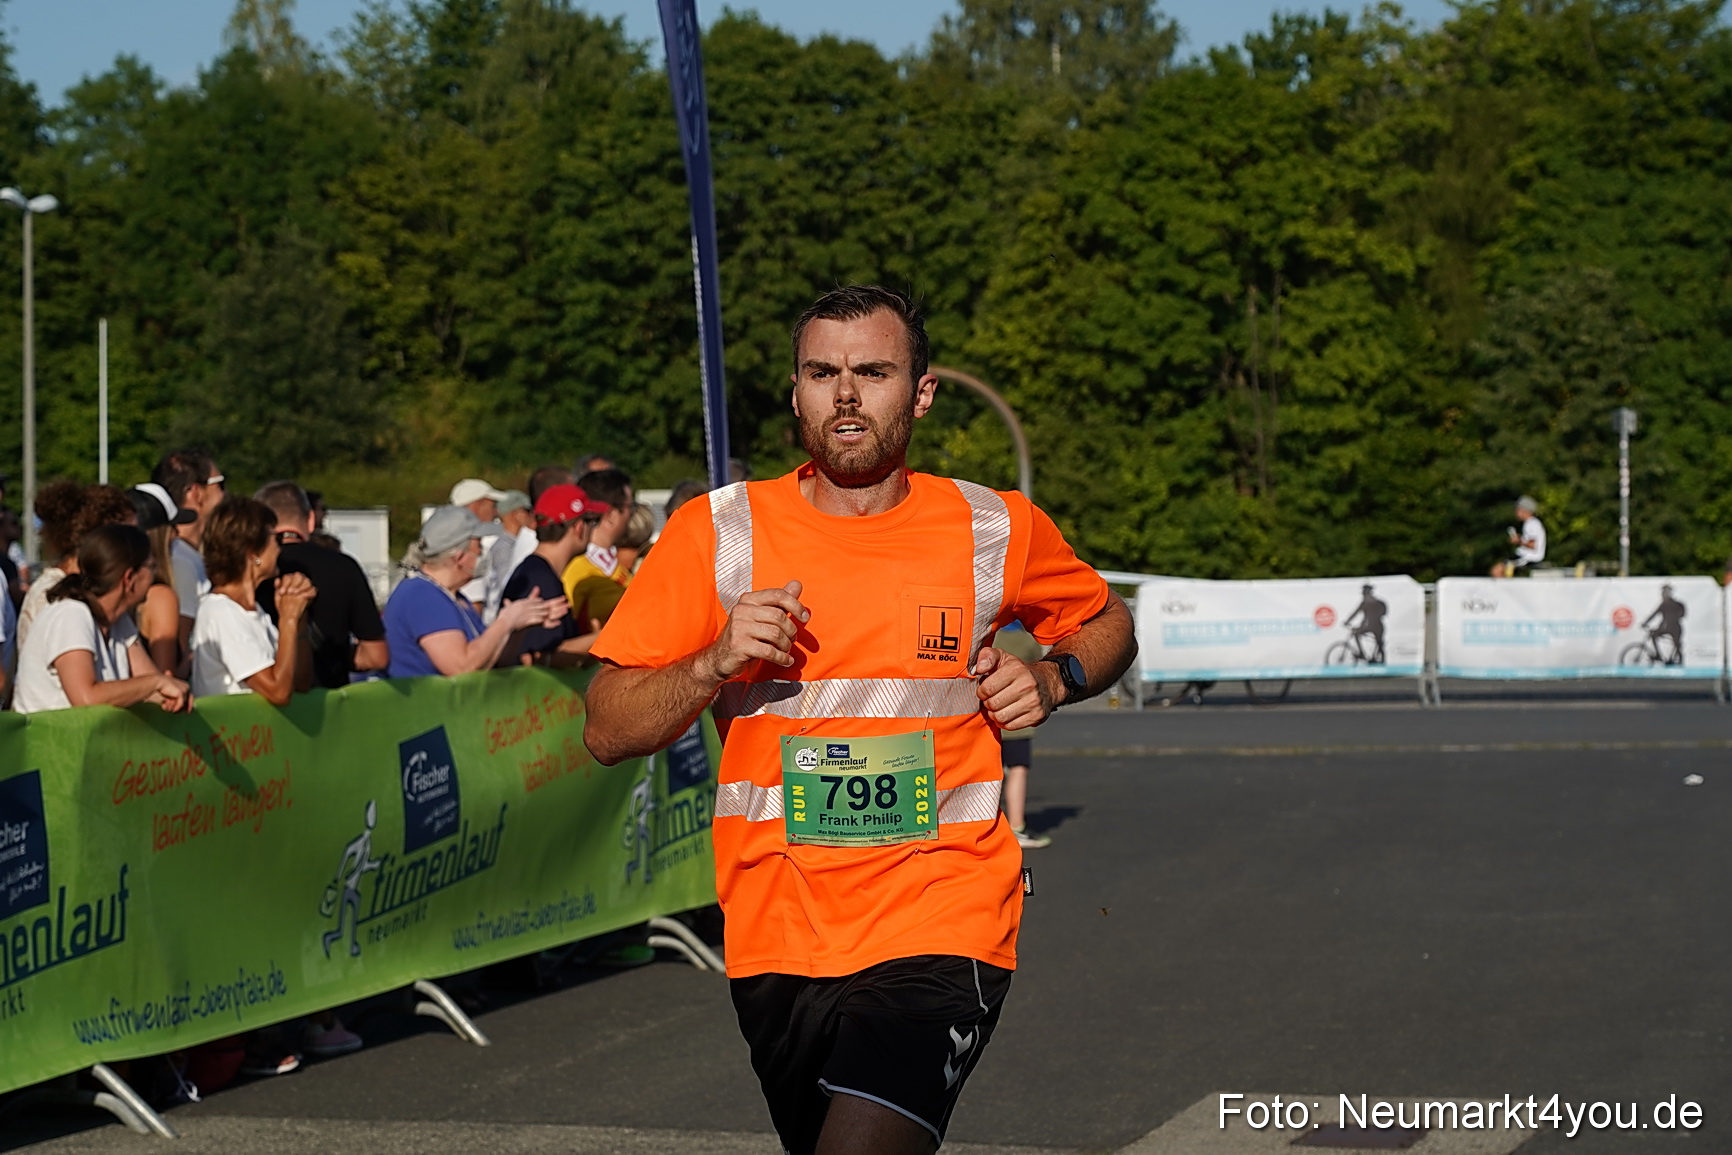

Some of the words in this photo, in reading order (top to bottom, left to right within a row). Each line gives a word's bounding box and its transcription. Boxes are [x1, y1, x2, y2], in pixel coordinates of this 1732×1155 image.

[939, 654, 958, 662] BÖGL
[112, 731, 207, 806] Gesunde
[209, 725, 275, 774] Firmen
[411, 764, 450, 796] Fischer
[820, 757, 868, 766] Firmenlauf
[153, 792, 216, 852] laufen
[222, 759, 292, 833] länger!
[792, 785, 806, 822] RUN
[820, 774, 898, 811] 798
[915, 775, 929, 825] 2022
[0, 821, 29, 850] cher
[819, 814, 859, 826] Frank
[862, 812, 903, 826] Philip
[368, 803, 508, 920] firmenlauf
